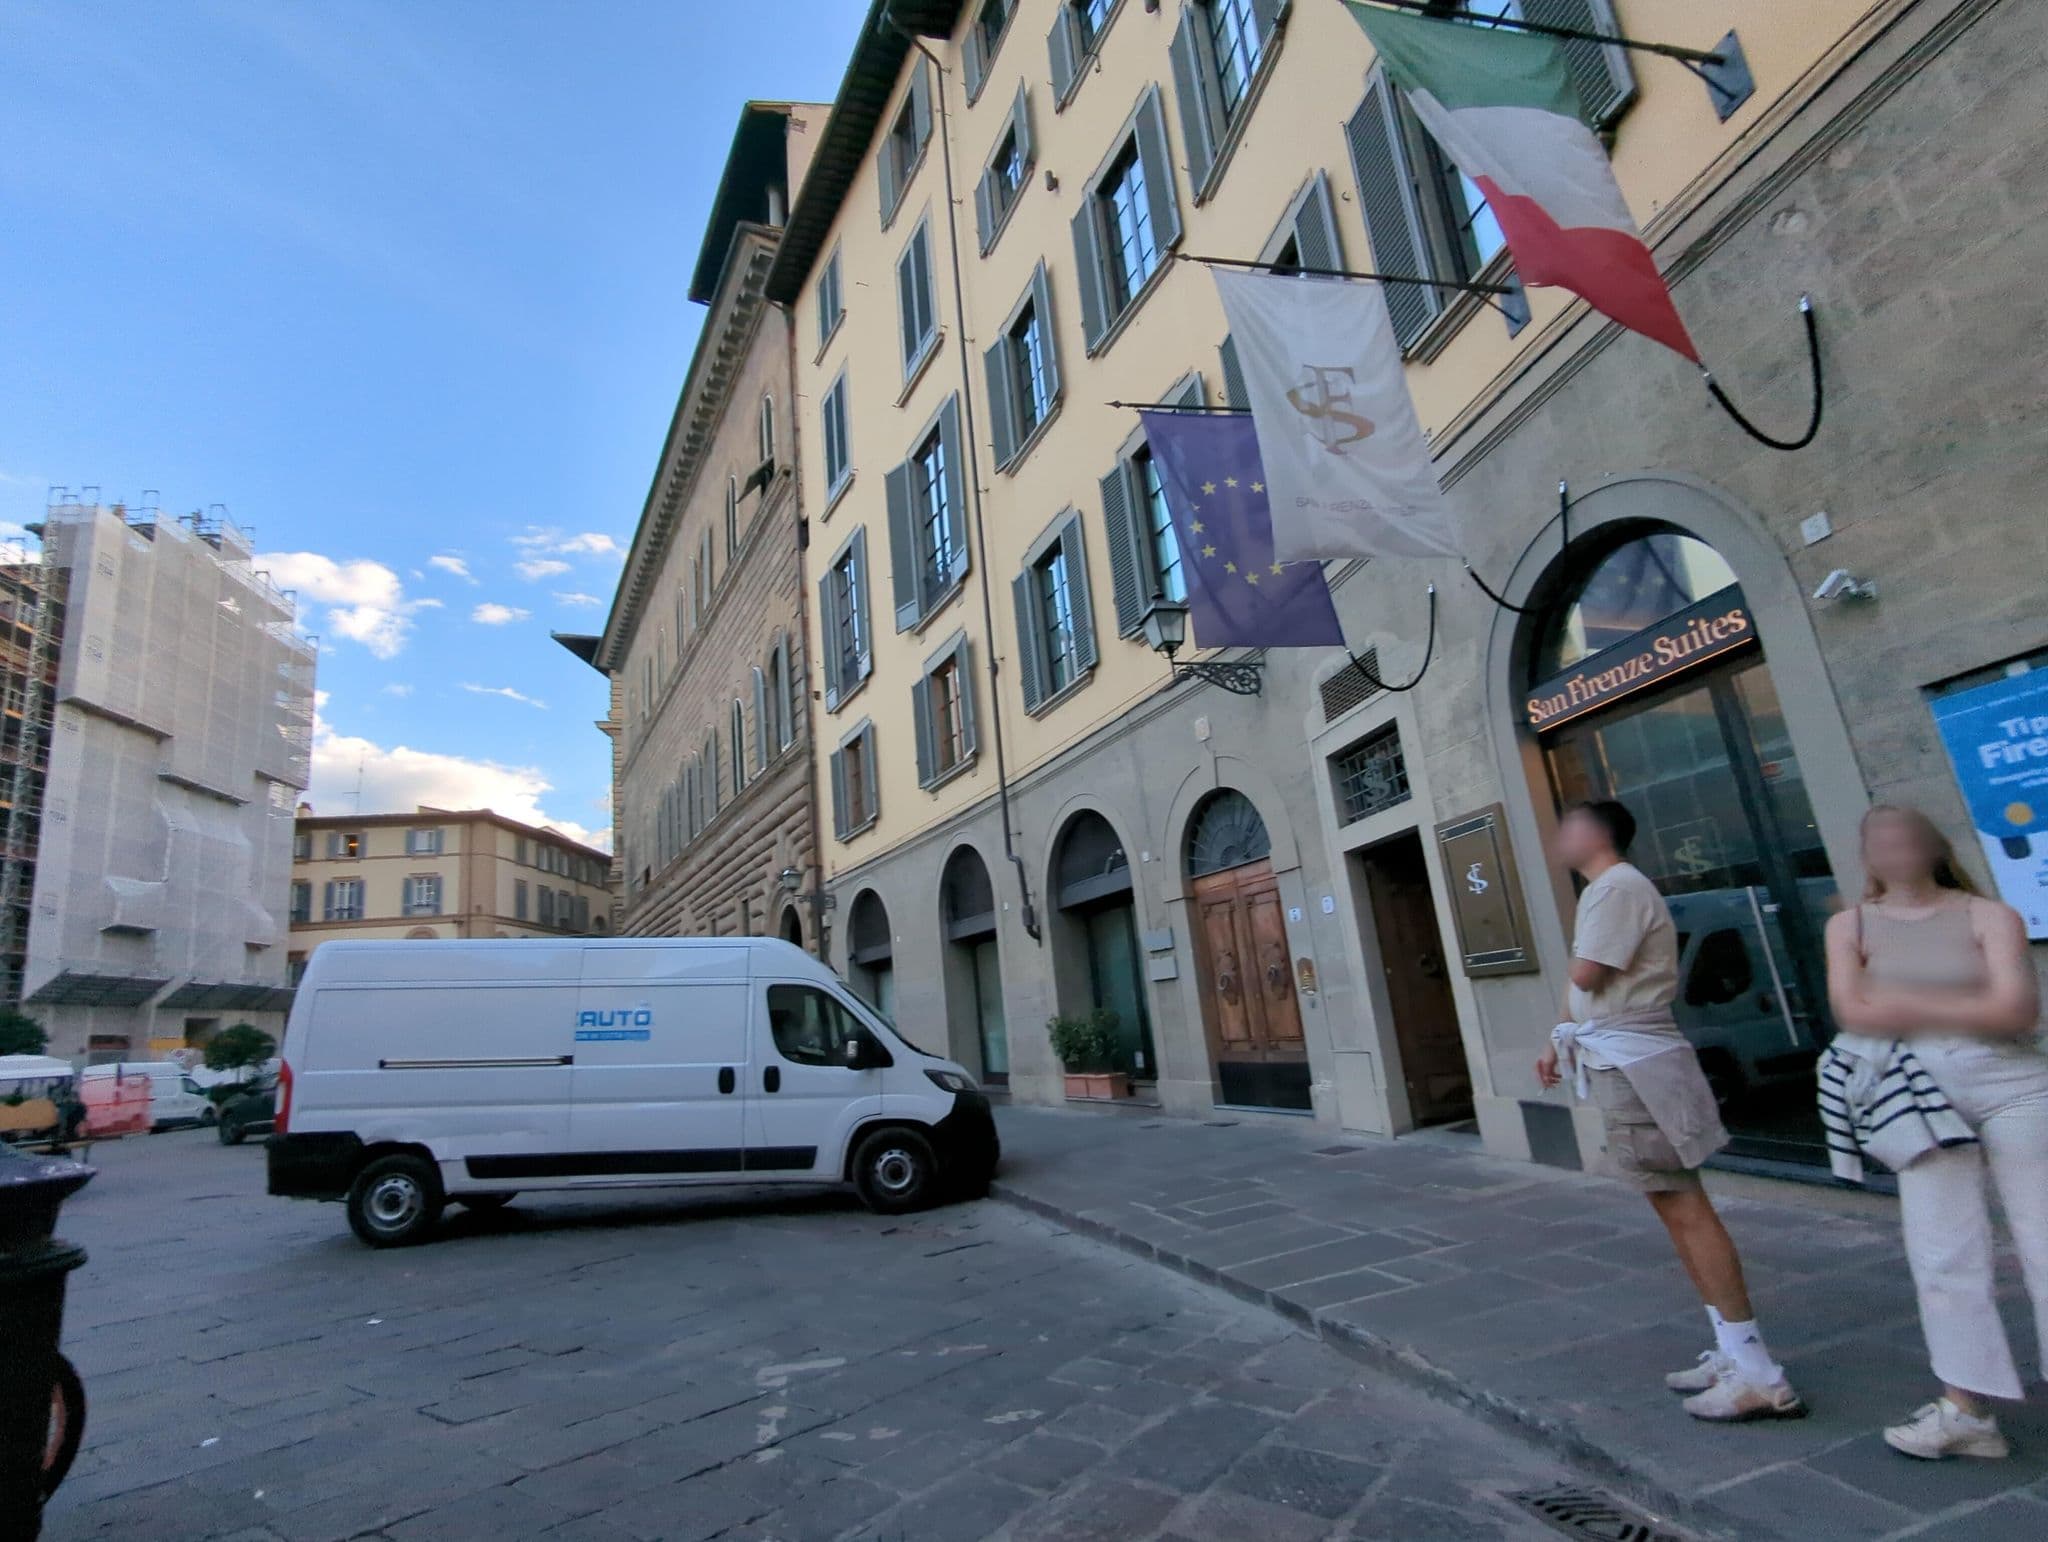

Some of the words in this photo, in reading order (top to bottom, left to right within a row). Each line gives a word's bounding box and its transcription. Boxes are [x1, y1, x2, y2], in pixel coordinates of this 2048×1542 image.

[1527, 692, 1571, 724] San
[1565, 653, 1654, 705] Firenze
[1653, 609, 1748, 667] Suites
